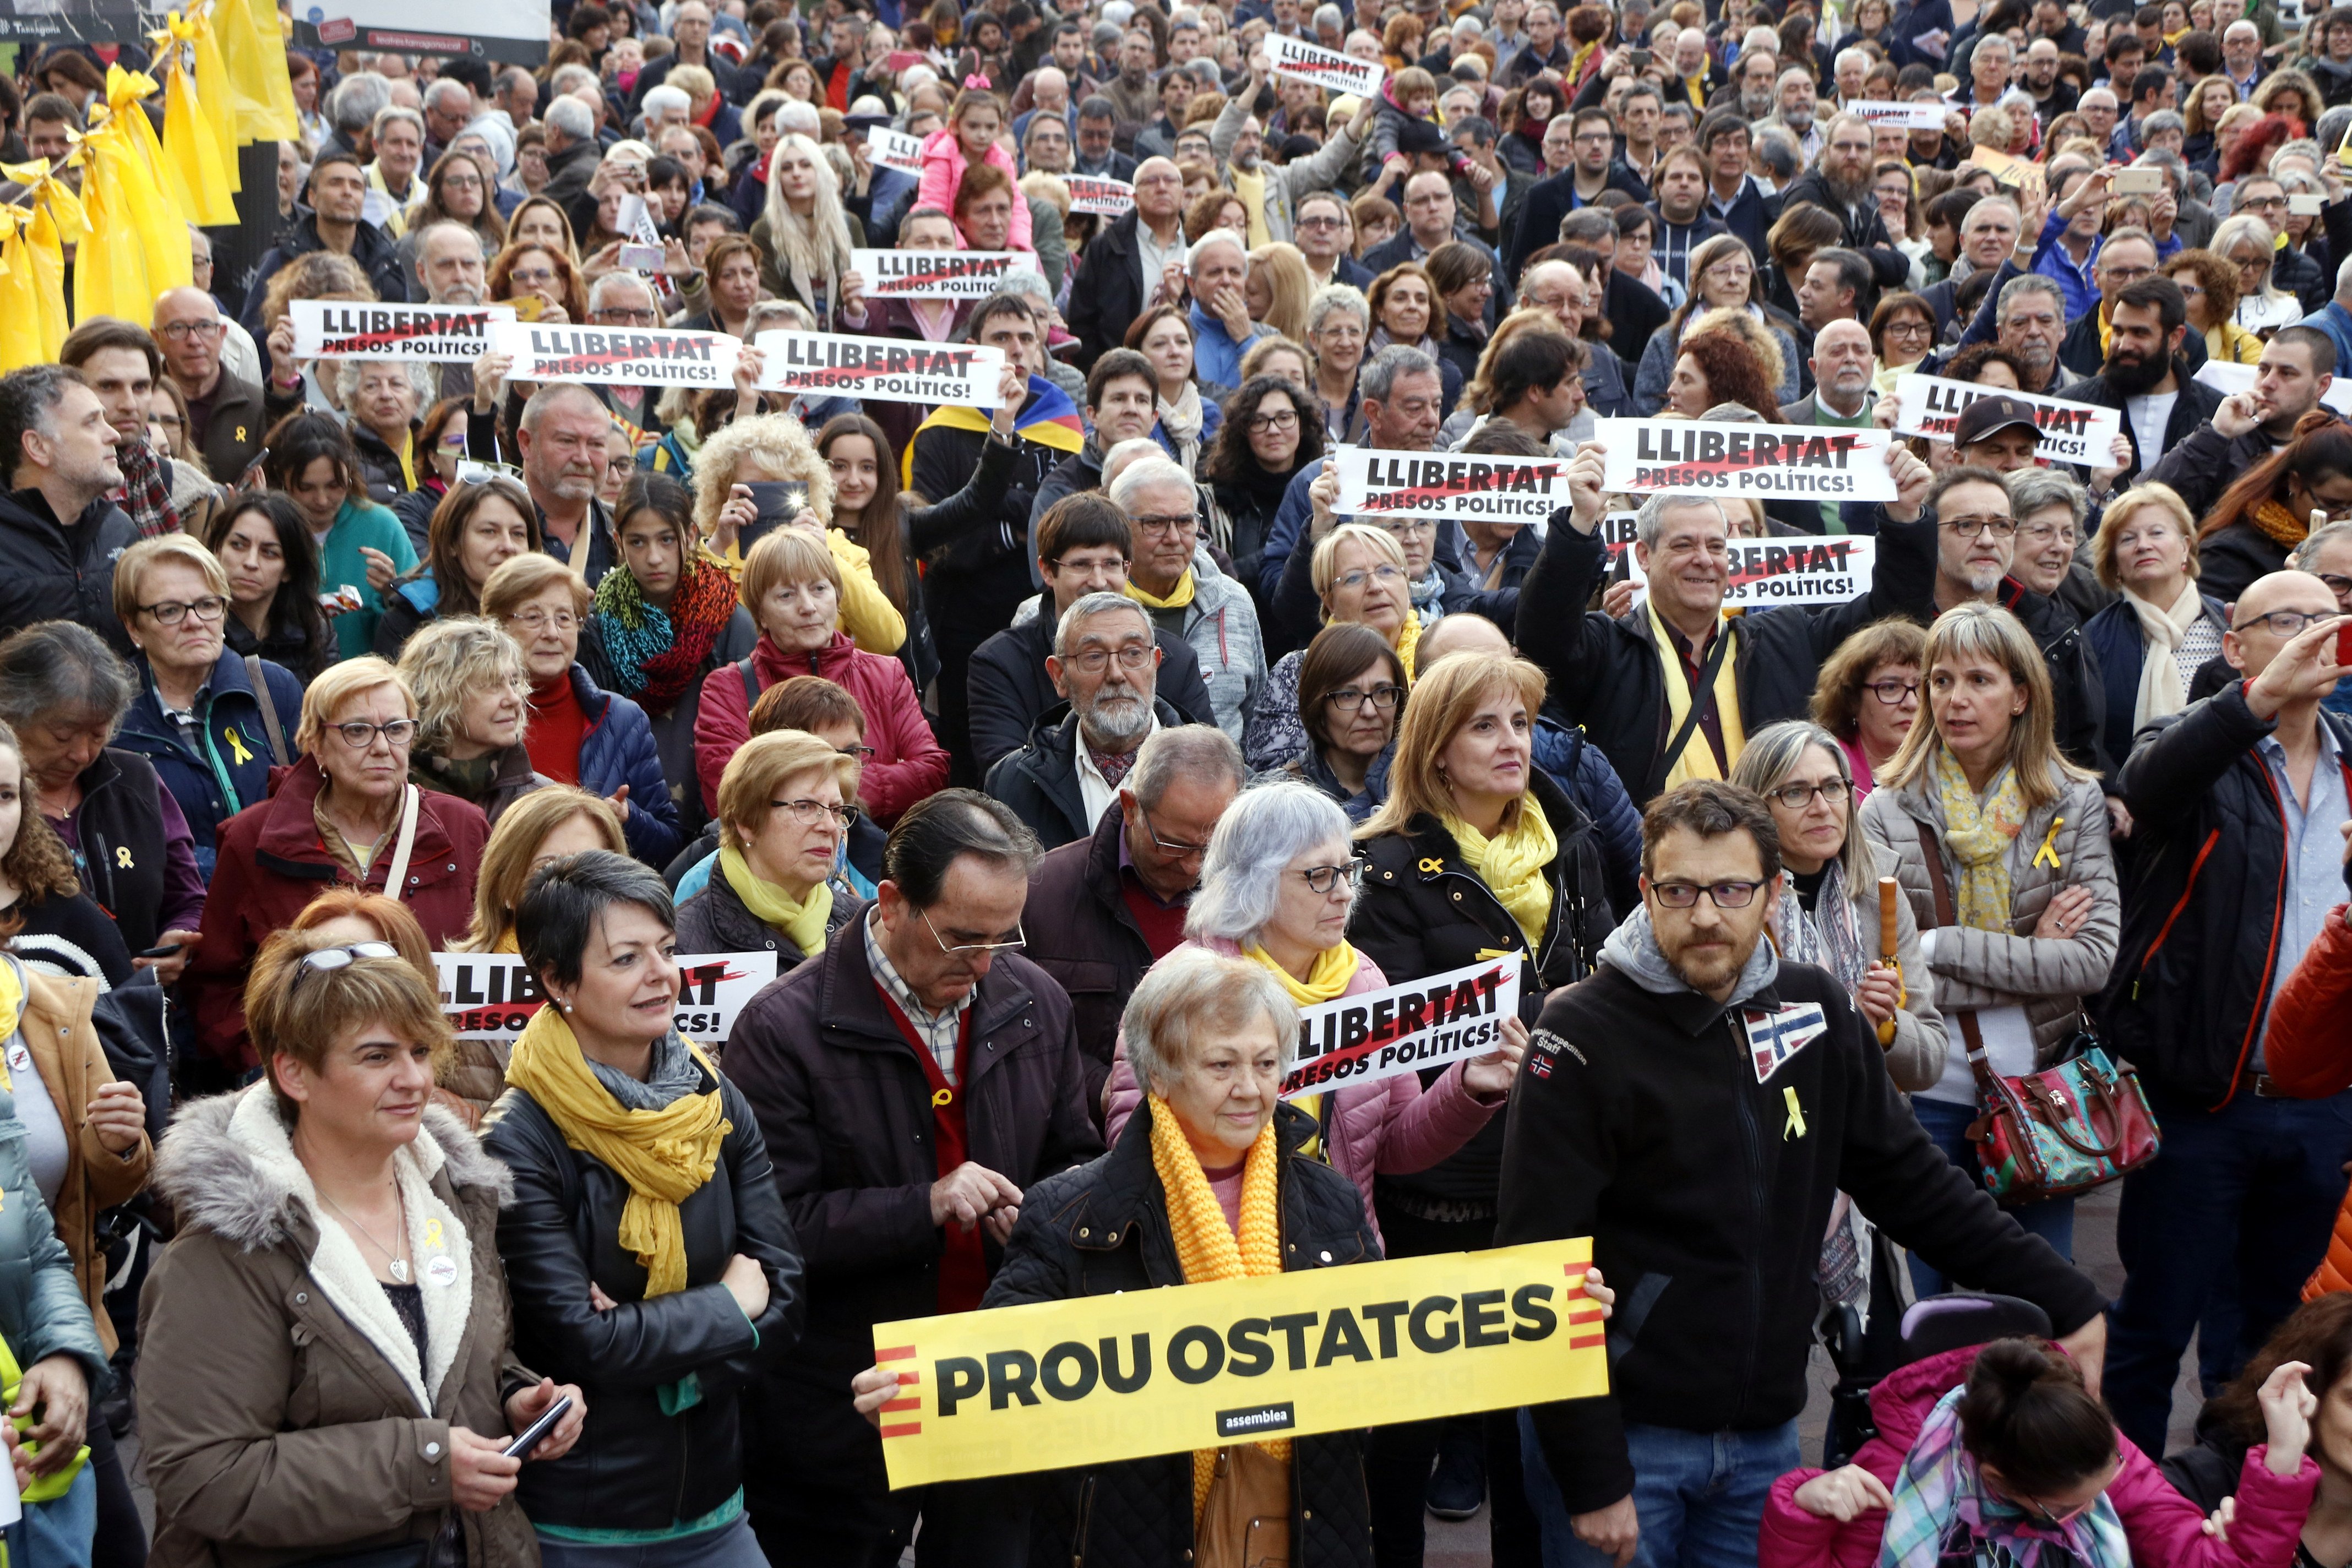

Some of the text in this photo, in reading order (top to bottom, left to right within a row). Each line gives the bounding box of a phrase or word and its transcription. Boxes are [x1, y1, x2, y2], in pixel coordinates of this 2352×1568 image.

[1282, 42, 1370, 80] LLIBERTAT
[878, 255, 1011, 277] LLIBERTAT
[878, 277, 997, 292] PRESOS POLÍTIC
[323, 309, 489, 337] LLIBERTAT
[323, 337, 488, 355] PRESOS POLÍTICS!
[531, 330, 714, 361] LLIBERTAT
[787, 339, 973, 378] LLIBERTAT
[535, 359, 717, 380] PRESOS POLÍTICS!
[786, 371, 971, 398] PRESOS POLÍTICS!
[1926, 384, 2093, 437] LLITAT
[1637, 428, 1855, 469] LLIBERTAT
[1367, 458, 1557, 494] LLIBERTAT
[1636, 467, 1854, 492] PRESOS POLÍTICS!
[1365, 492, 1554, 515] PRESOS POLÍTICS!
[1728, 543, 1850, 576] BERTAT
[1756, 575, 1854, 597] POLÍTICS!
[1292, 970, 1501, 1061] LIBERTAT
[1380, 1019, 1500, 1069] POLÍTICS!
[1537, 1036, 1561, 1054] Staff
[1551, 1034, 1587, 1065] expedition
[935, 1333, 1152, 1417] PROU
[1166, 1283, 1558, 1386] OSTATGES
[1226, 1409, 1287, 1429] assemblea
